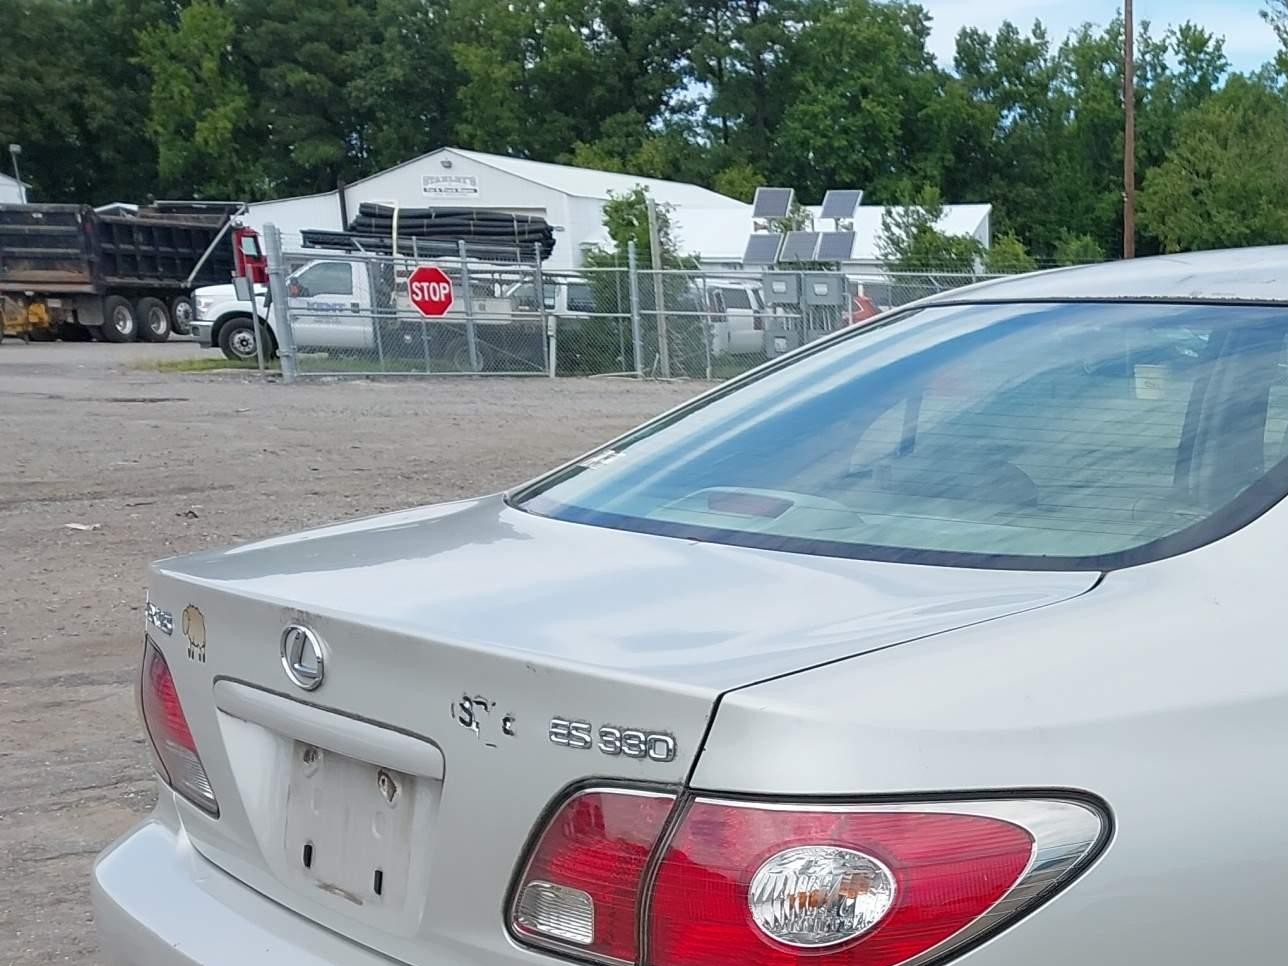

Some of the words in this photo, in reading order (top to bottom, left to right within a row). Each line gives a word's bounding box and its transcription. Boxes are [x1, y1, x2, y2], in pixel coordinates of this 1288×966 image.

[412, 281, 450, 302] STOP
[549, 716, 592, 750] ES
[598, 723, 677, 763] 330
